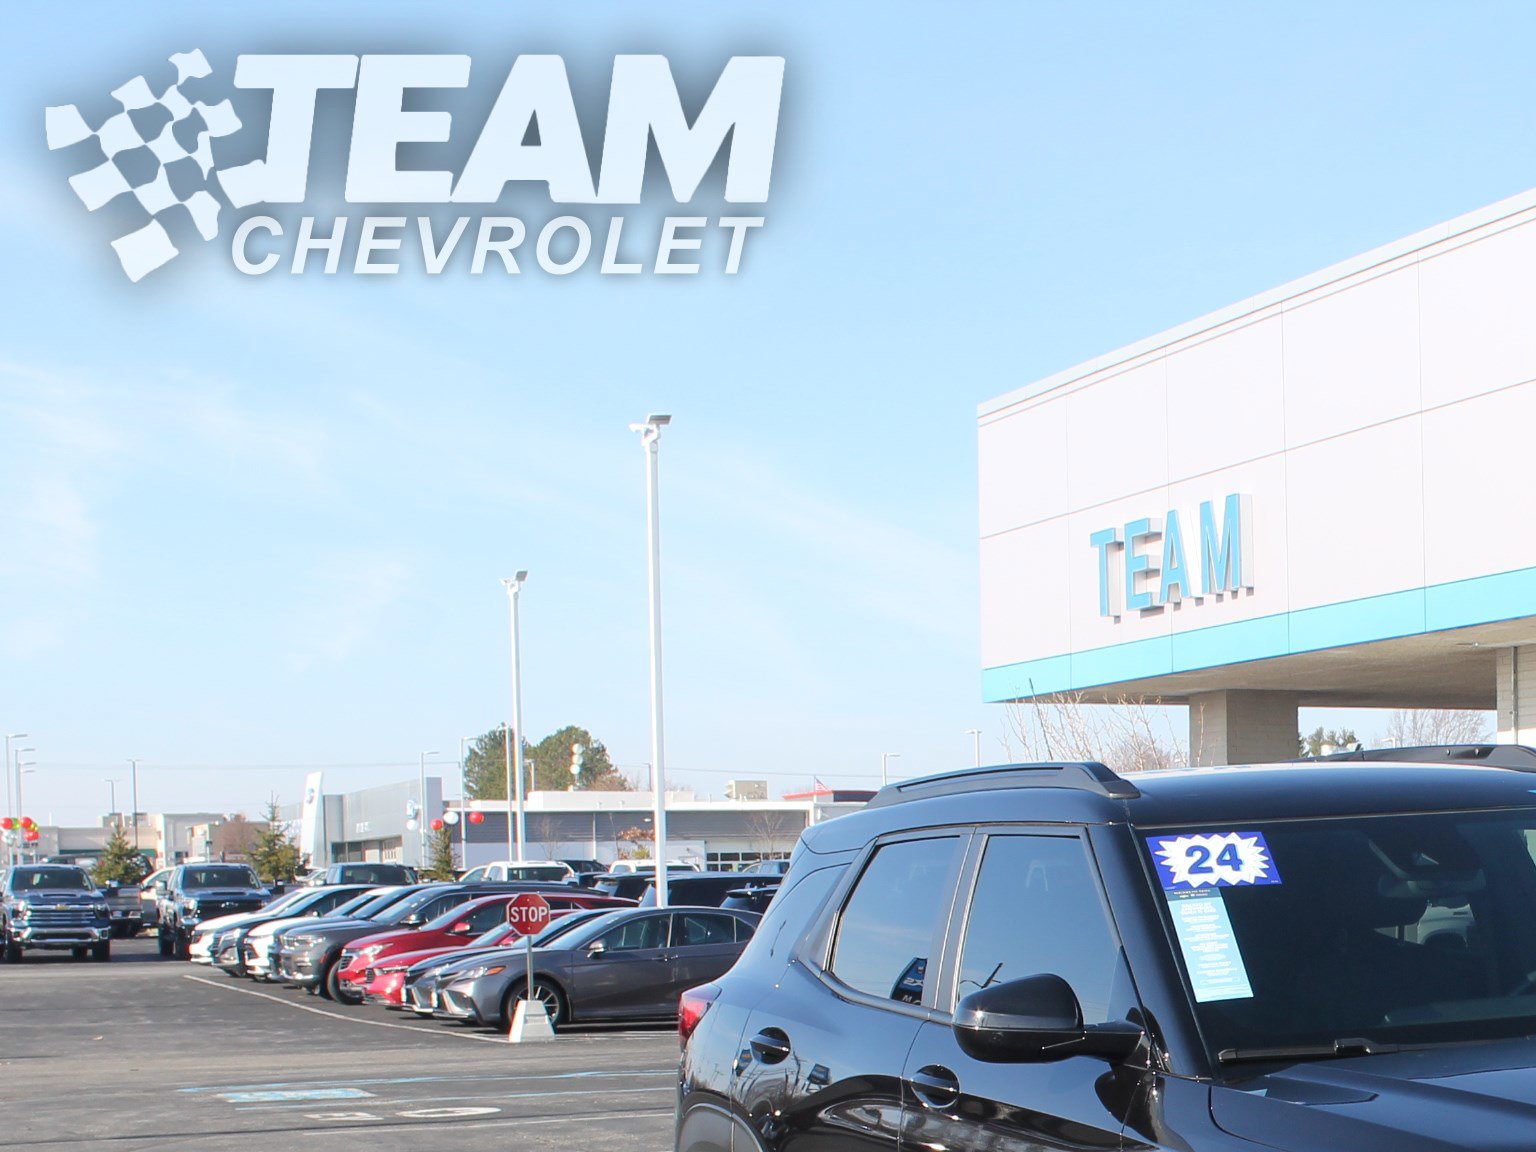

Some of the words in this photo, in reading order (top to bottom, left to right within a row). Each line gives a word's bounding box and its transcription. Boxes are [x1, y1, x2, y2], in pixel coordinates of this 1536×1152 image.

[1090, 493, 1251, 617] TEAM
[1186, 844, 1243, 875] 24
[510, 906, 548, 922] STOP
